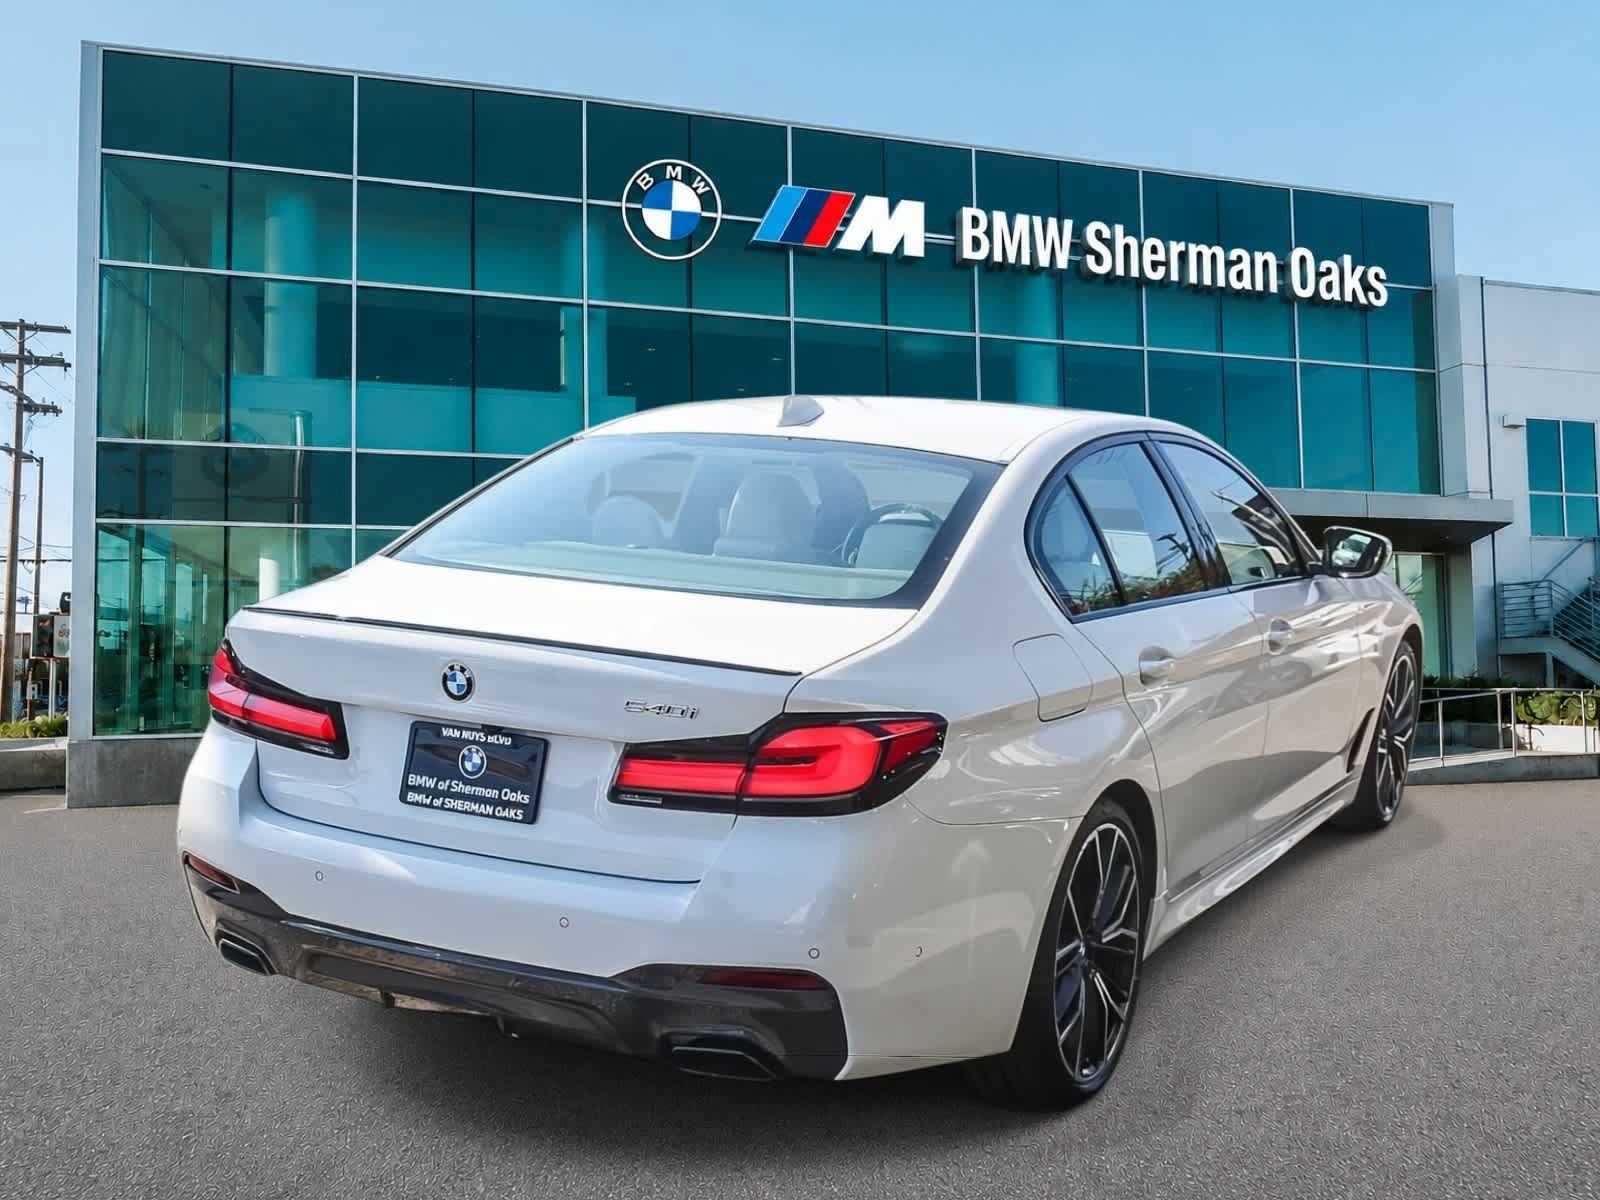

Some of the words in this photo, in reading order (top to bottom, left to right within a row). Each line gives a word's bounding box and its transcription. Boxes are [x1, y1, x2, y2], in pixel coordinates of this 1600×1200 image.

[635, 164, 711, 194] BMW
[961, 206, 1073, 269] BMW
[1084, 221, 1278, 293] Sherman
[1289, 247, 1388, 307] Oaks
[624, 699, 699, 719] 540i
[441, 727, 460, 738] VAN
[461, 730, 486, 742] NUYS
[487, 735, 512, 745] BLVD
[407, 774, 437, 788] BMW
[437, 779, 450, 790] of
[450, 781, 499, 799] Sherman
[501, 788, 530, 804] Oaks
[407, 792, 432, 805] BMW
[432, 797, 443, 807] of
[443, 798, 494, 815] SHERMAN
[495, 807, 524, 820] OAKS
